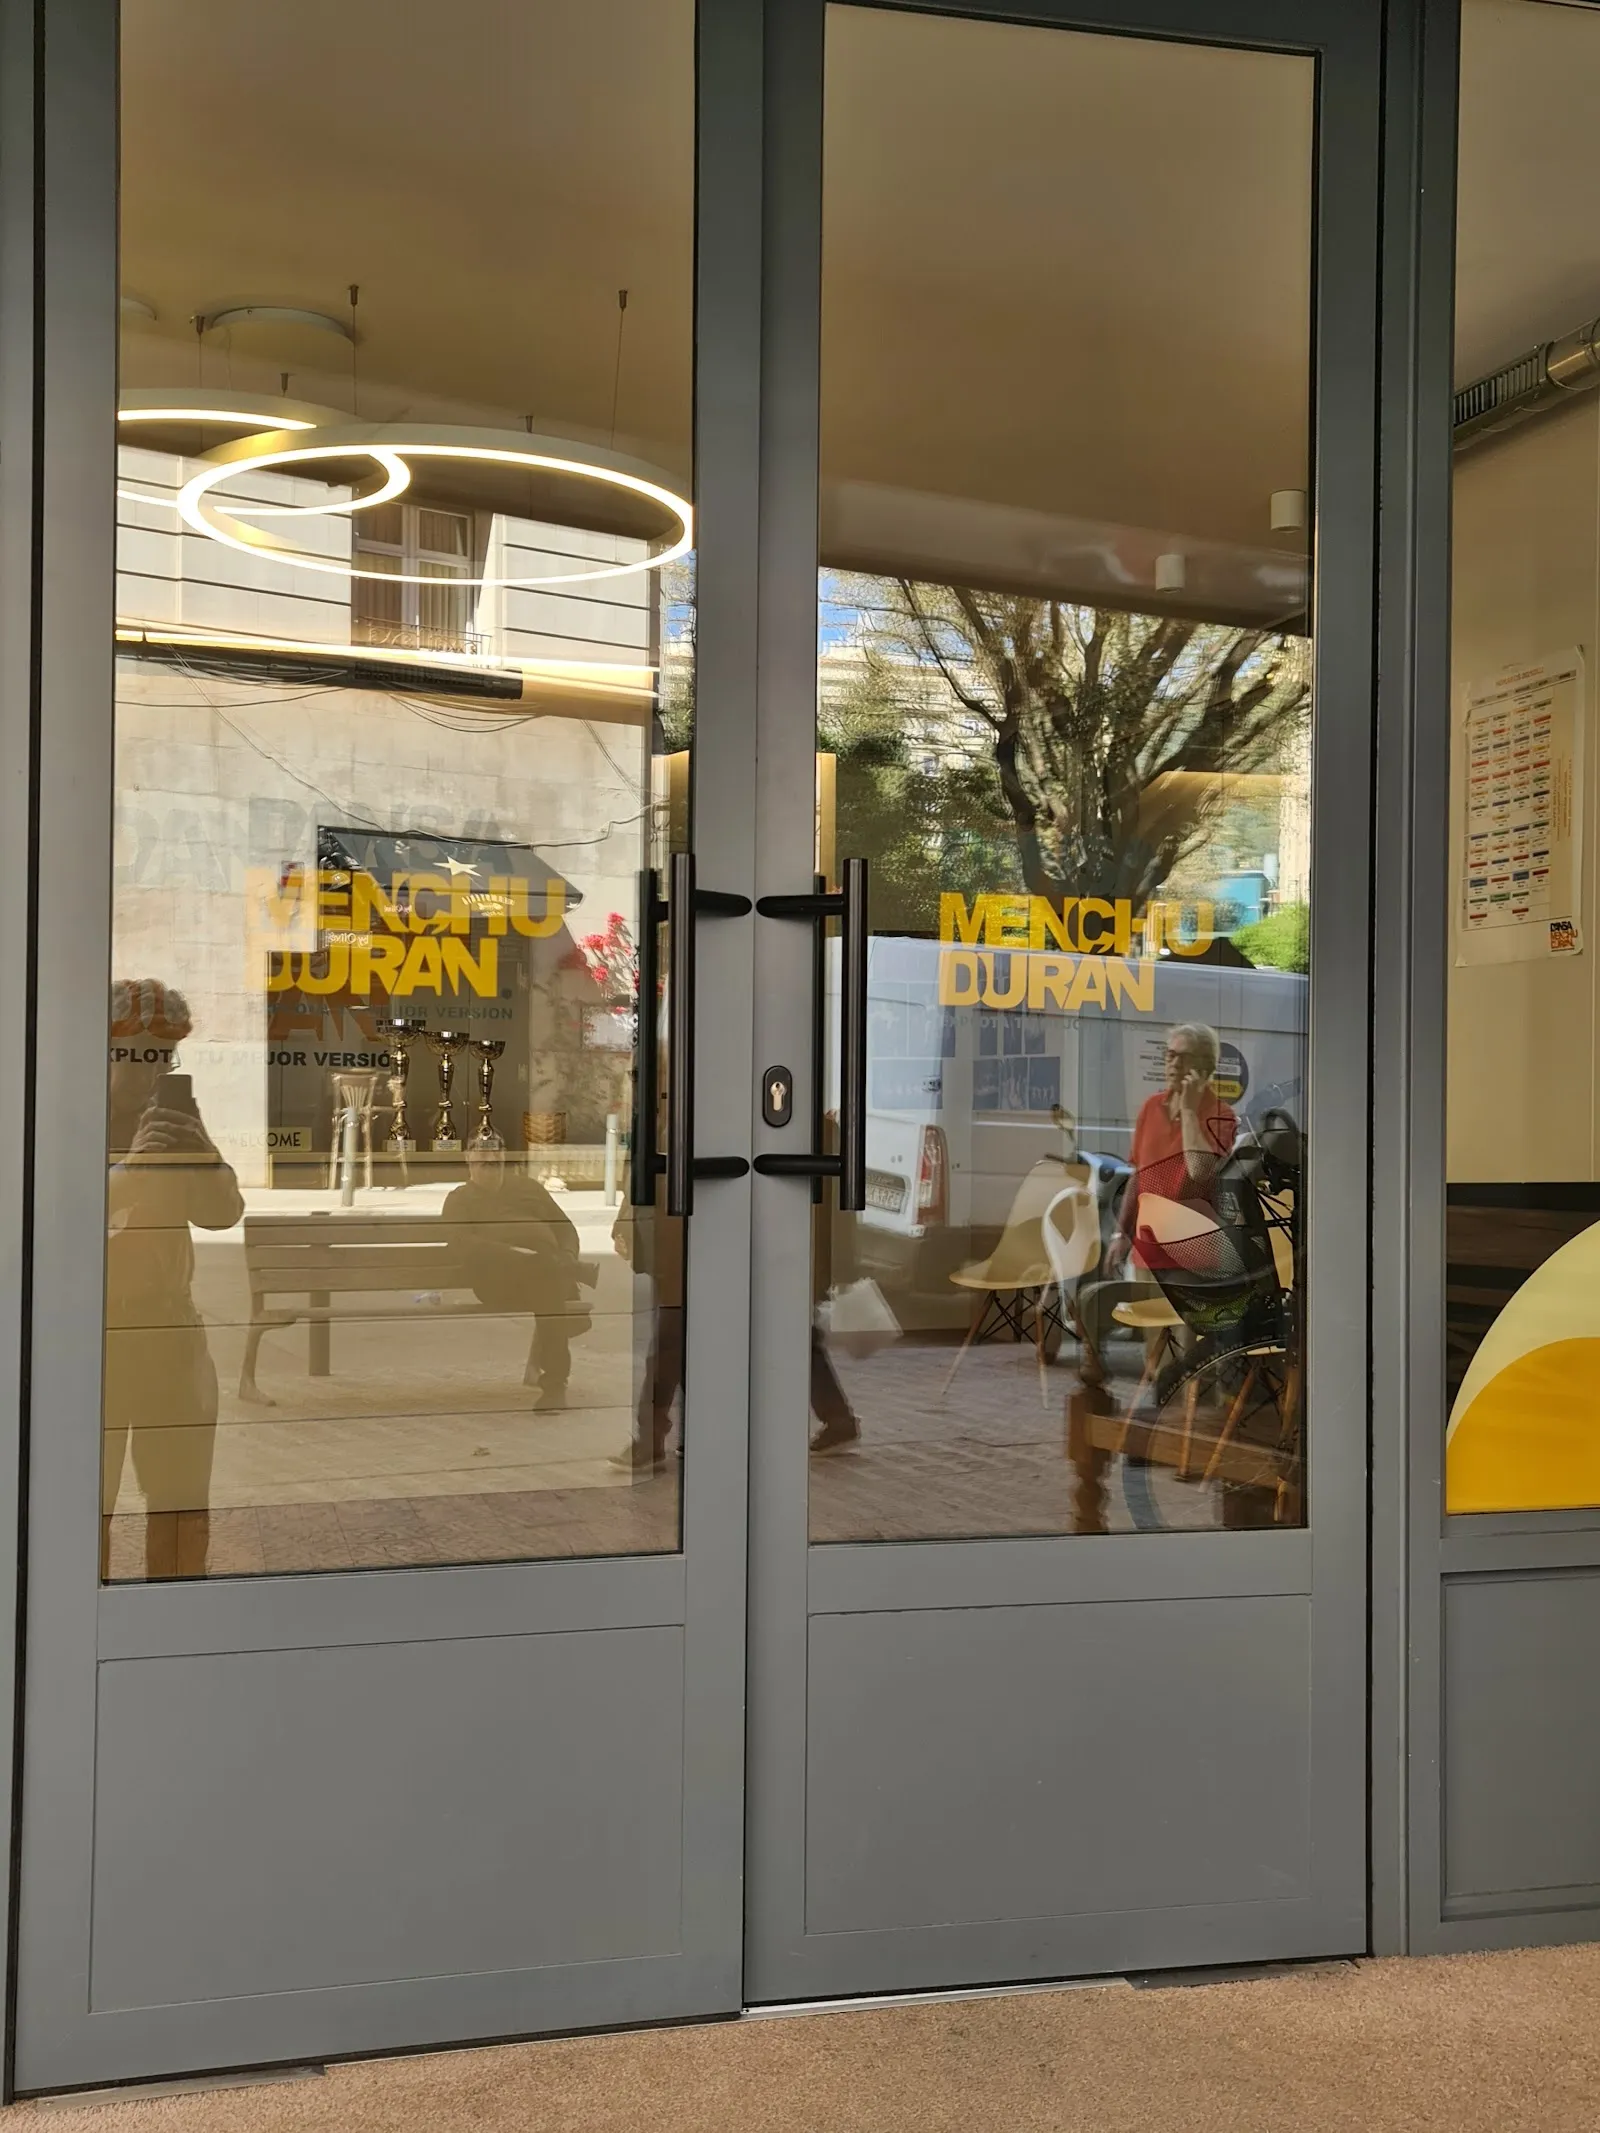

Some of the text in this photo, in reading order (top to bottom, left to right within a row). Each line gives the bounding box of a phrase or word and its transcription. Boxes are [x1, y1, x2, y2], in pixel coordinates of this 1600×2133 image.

[246, 868, 567, 938] MENCHU
[940, 892, 1215, 958] MENCHU
[313, 1049, 393, 1068] VERSIÓ
[227, 1131, 302, 1148] WELCOME
